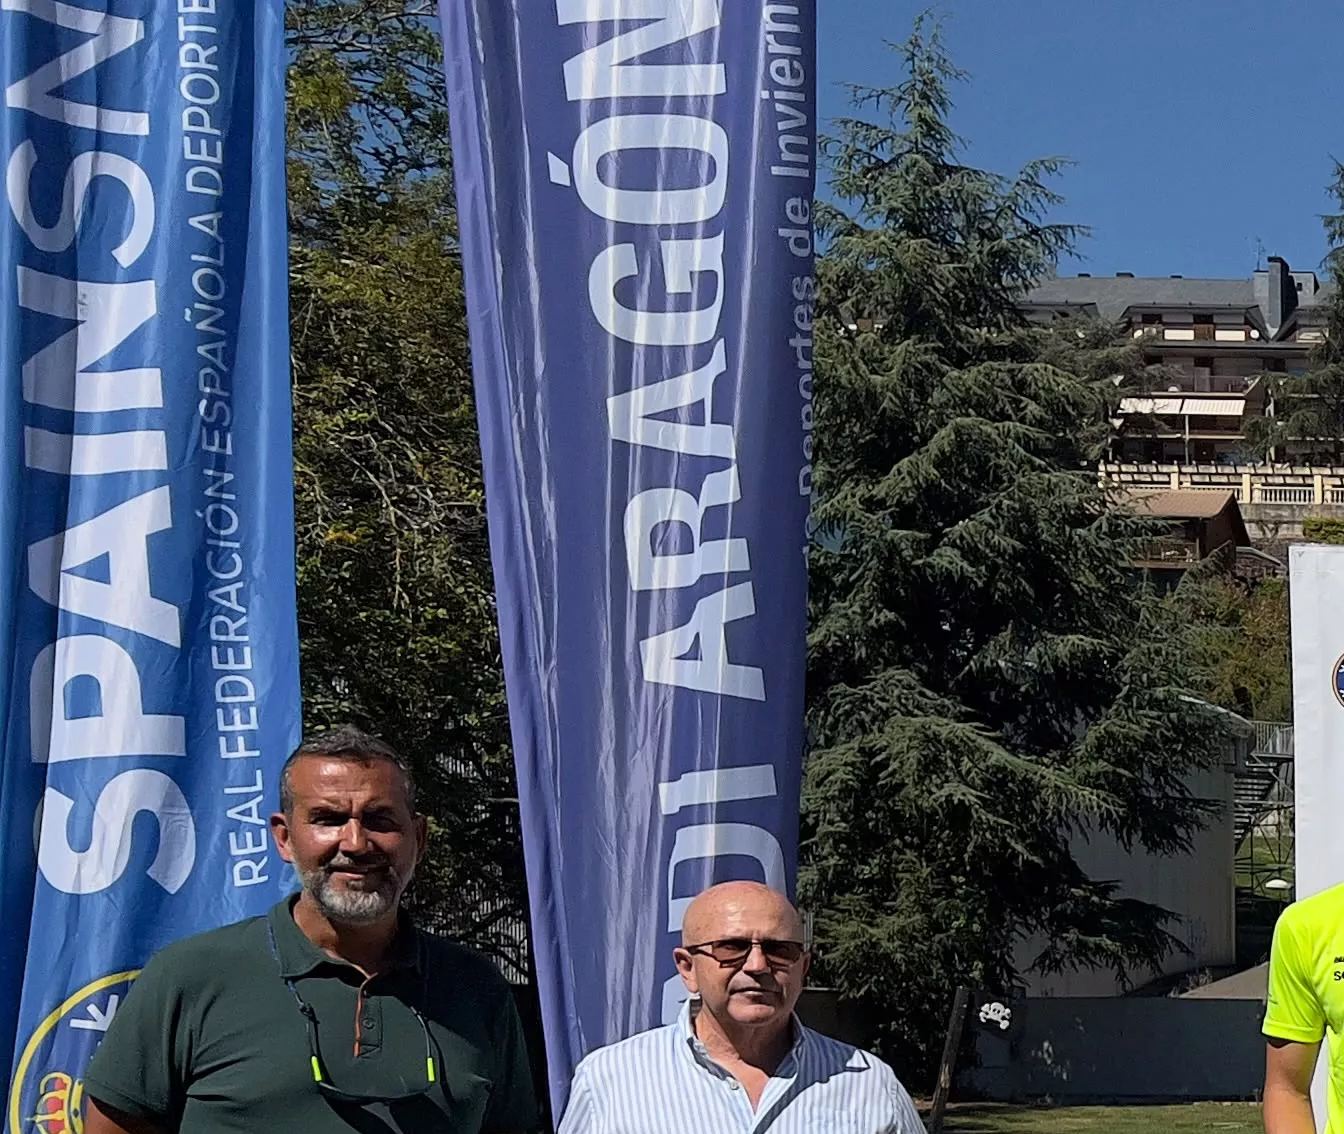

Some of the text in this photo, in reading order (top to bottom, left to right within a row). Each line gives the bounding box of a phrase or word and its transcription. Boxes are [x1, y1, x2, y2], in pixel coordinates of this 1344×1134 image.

[184, 211, 234, 457] ESPAÑOLA
[548, 0, 767, 701] ARAGÓN
[196, 468, 261, 760] FEDERACIÓN
[224, 769, 270, 888] REAL
